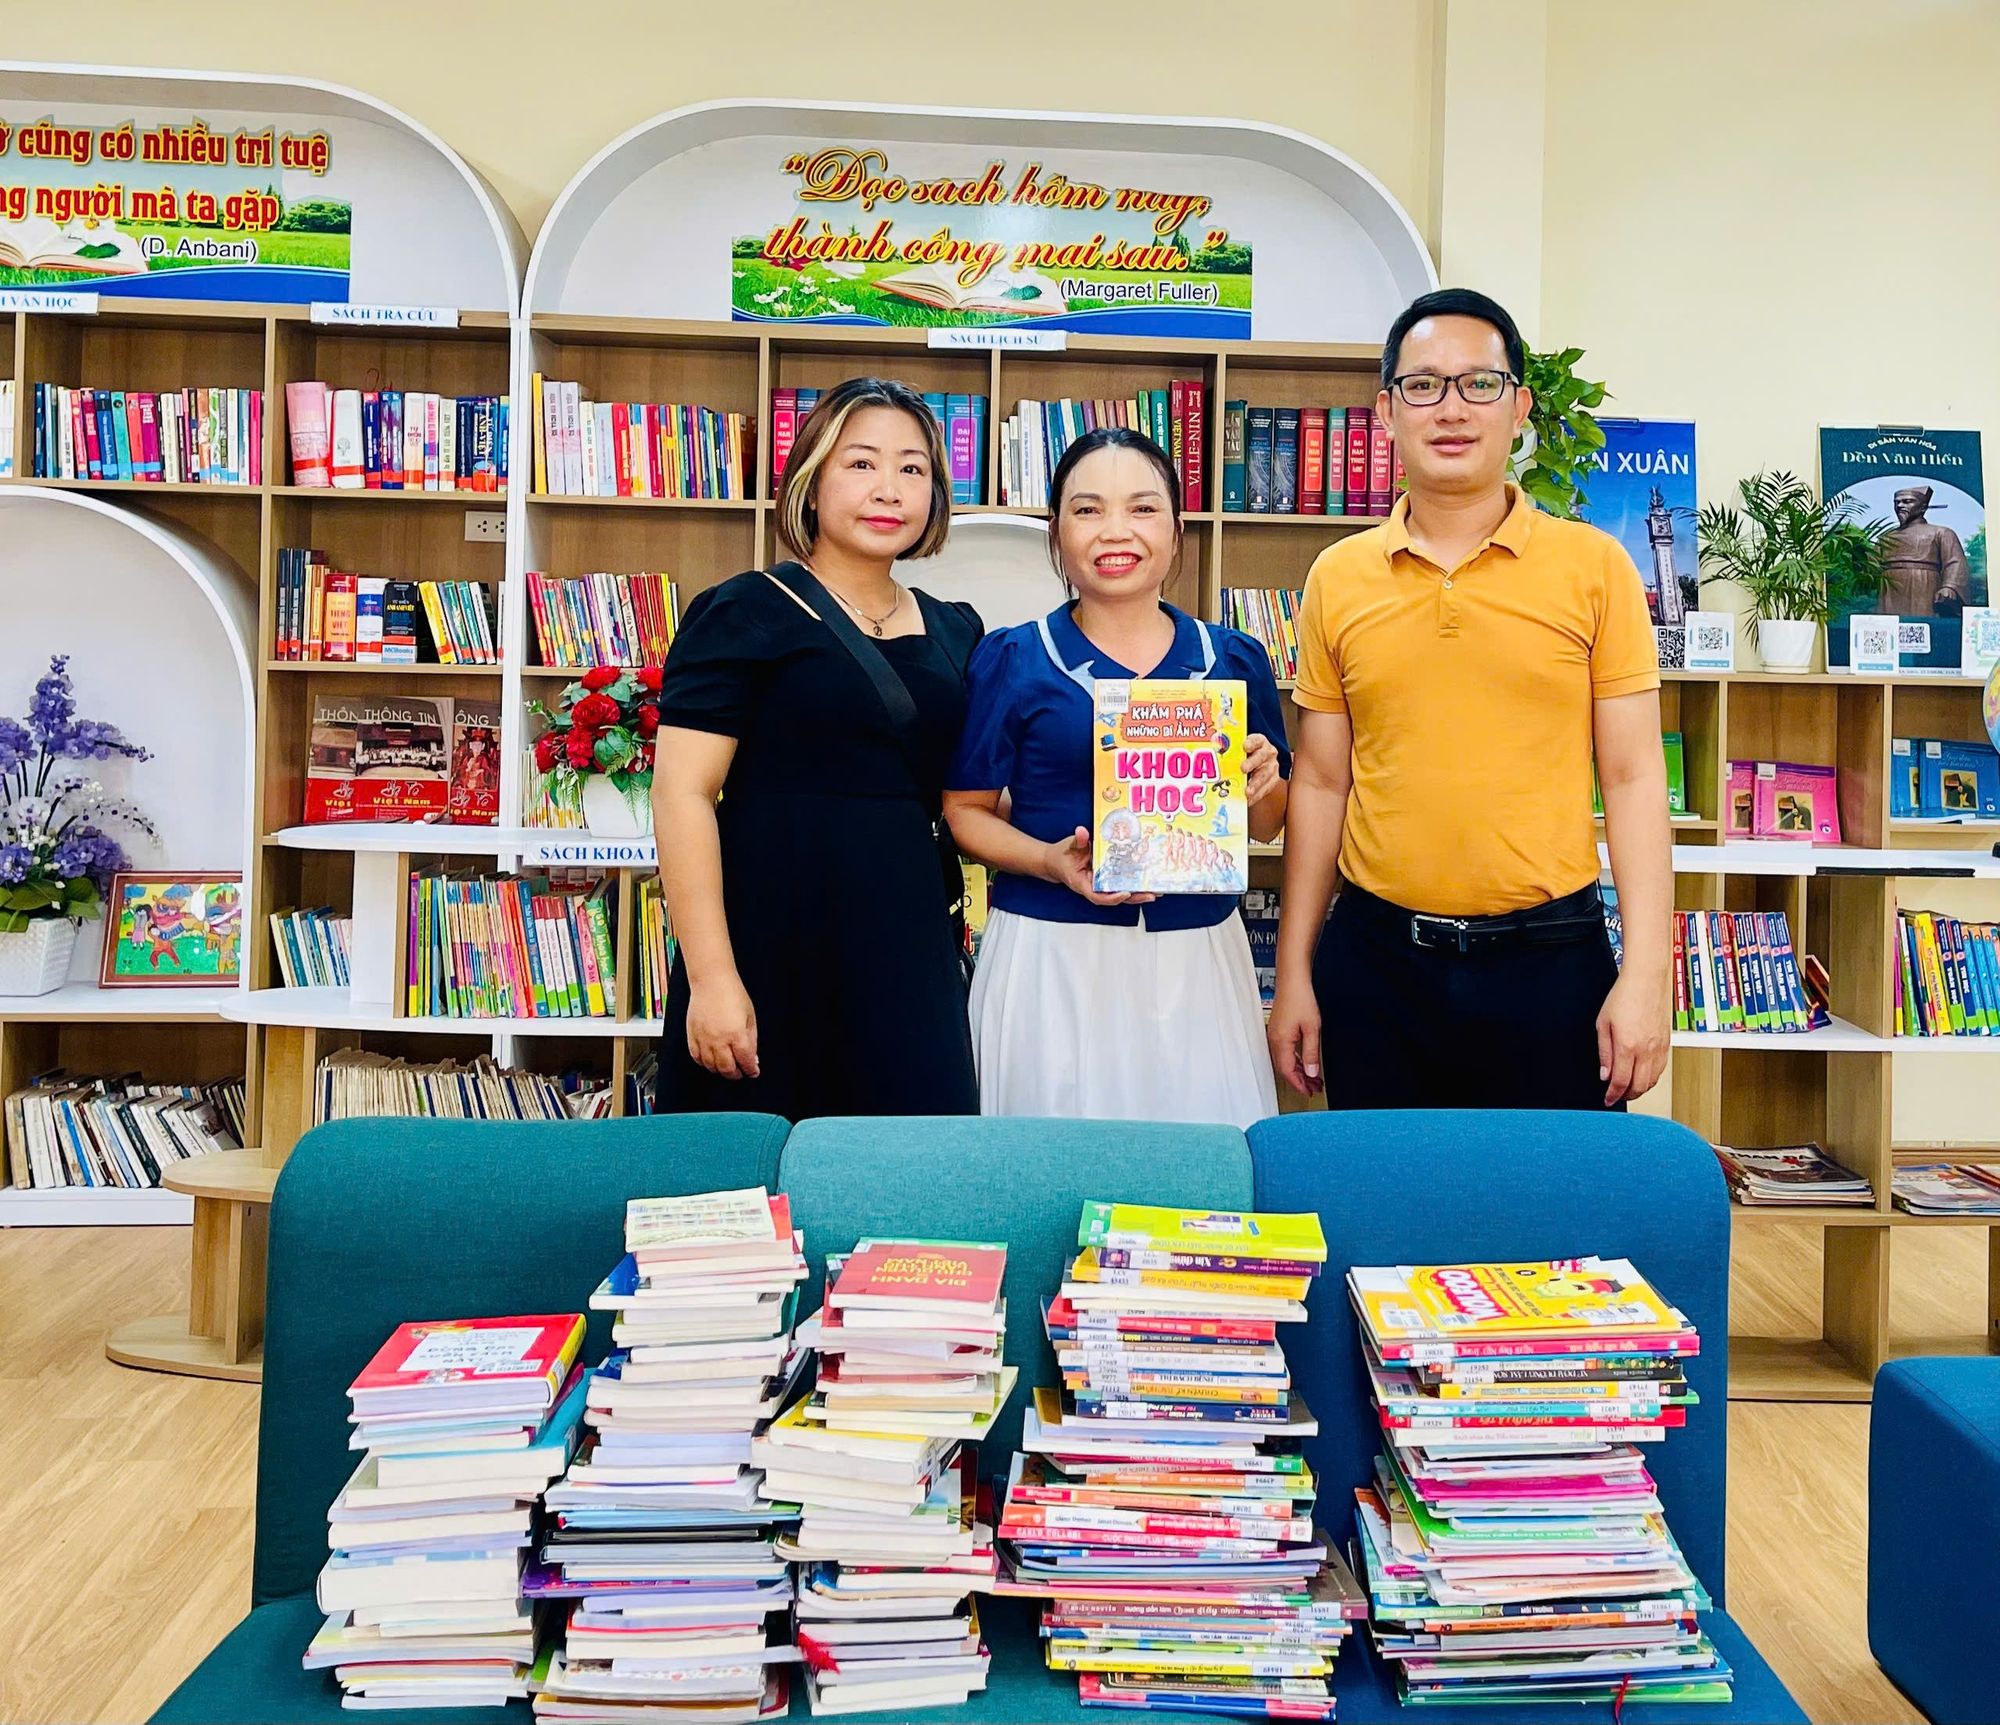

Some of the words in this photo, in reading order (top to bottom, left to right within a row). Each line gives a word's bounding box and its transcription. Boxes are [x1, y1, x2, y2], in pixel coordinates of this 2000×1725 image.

[18, 122, 92, 164] cũng
[99, 121, 135, 161] có
[142, 119, 226, 164] nhiều
[234, 131, 272, 166] trí
[282, 131, 329, 175] tuệ
[1012, 160, 1106, 210] hôm
[36, 182, 122, 222] người
[131, 184, 177, 223] mà
[187, 191, 218, 222] ta
[225, 190, 280, 231] gặp
[141, 236, 172, 259] (D.
[177, 237, 258, 263] Anbani)
[764, 217, 894, 263] thành
[900, 228, 1003, 289] công
[1013, 233, 1104, 270] mai
[46, 297, 78, 310] HỌC
[1060, 280, 1155, 304] (Margaret
[1157, 282, 1219, 306] Fuller)
[332, 306, 371, 320] SÁCH
[376, 309, 403, 320] TRA
[407, 308, 438, 321] CỨU
[1617, 447, 1690, 475] XUÂN
[364, 706, 412, 722] THÔNG
[417, 711, 437, 725] TIN
[1131, 702, 1170, 721] KHÁM
[1175, 702, 1204, 720] PHÁ
[1126, 725, 1160, 737] NHỮNG
[1163, 724, 1174, 737] BÍ
[1193, 723, 1207, 737] VỀ
[1117, 750, 1218, 780] KHOA
[1131, 784, 1205, 820] HỌC
[540, 844, 587, 860] SÁCH
[593, 847, 645, 861] KHOA
[1247, 929, 1265, 945] ÔN
